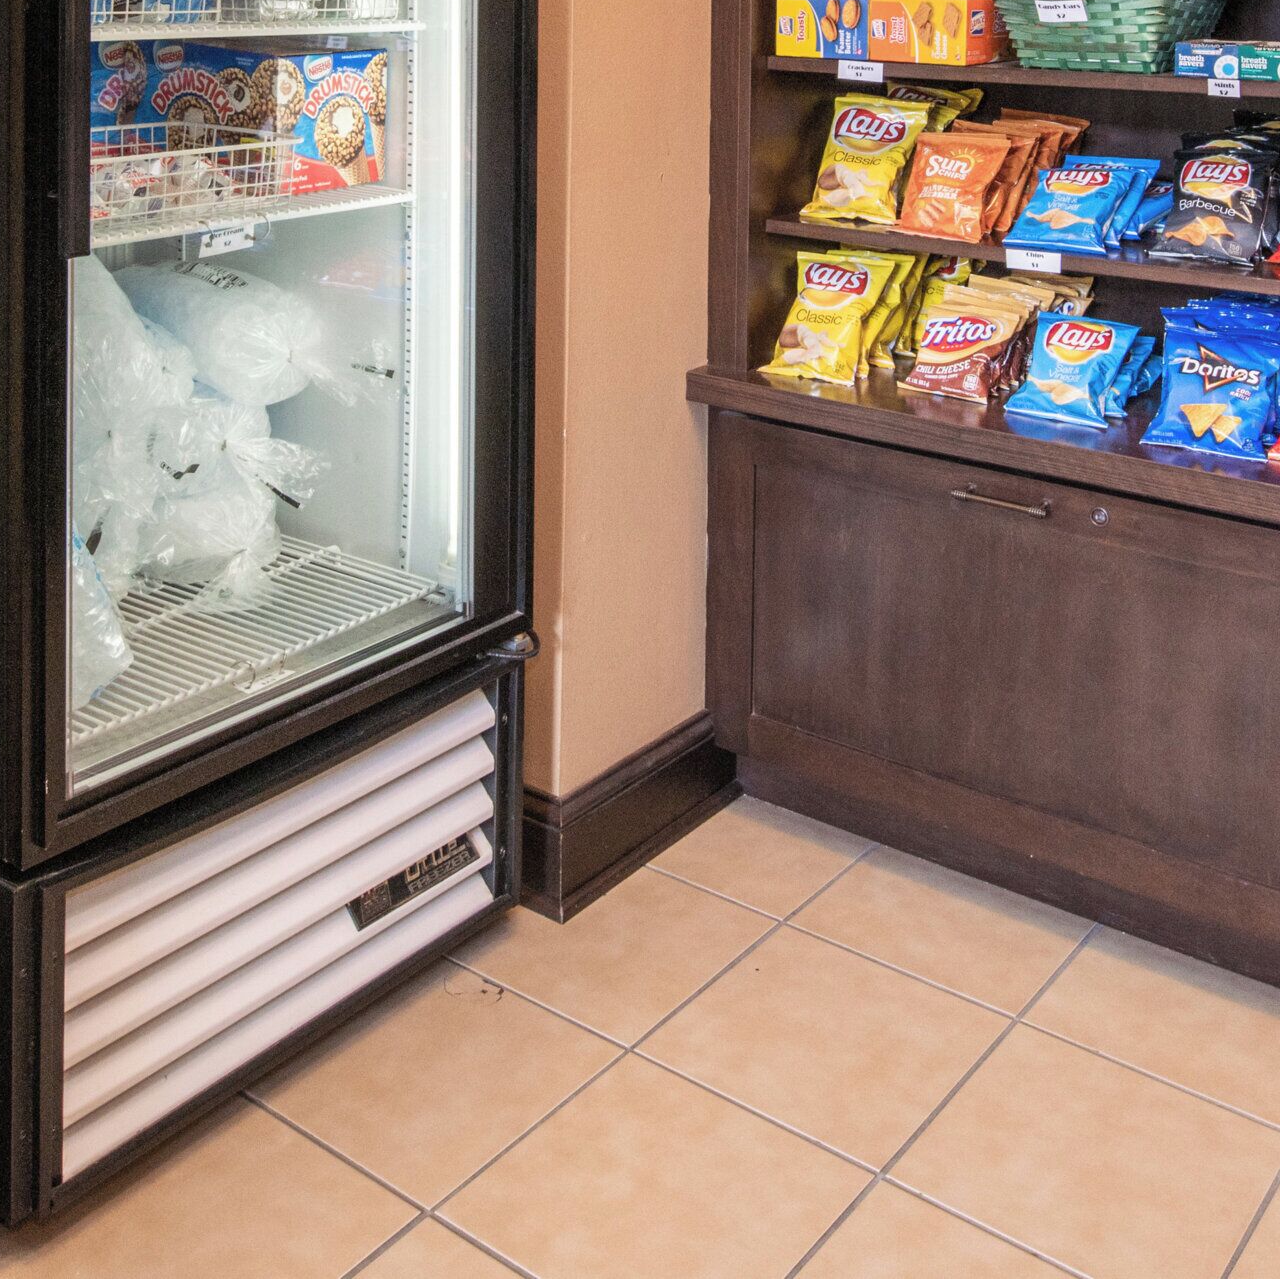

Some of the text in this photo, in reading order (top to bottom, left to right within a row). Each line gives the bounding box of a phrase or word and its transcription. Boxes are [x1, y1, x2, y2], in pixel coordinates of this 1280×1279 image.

[1038, 4, 1061, 13] Candy
[796, 10, 807, 42] Toasty
[837, 29, 845, 54] Peanut
[844, 31, 852, 54] Butter
[1178, 53, 1204, 62] breath
[1240, 56, 1268, 64] breath
[150, 68, 235, 125] DRUMSTICK
[303, 73, 375, 119] DRUMSTICK
[835, 108, 906, 144] Lay's
[833, 150, 883, 166] Classic
[925, 154, 971, 177] Sun
[937, 168, 968, 181] CHIPS
[1184, 161, 1250, 185] Lay's
[1047, 201, 1082, 211] Vinegar
[1178, 198, 1237, 218] Barbecue
[1026, 252, 1045, 260] Chips
[795, 306, 843, 326] Classic
[922, 316, 997, 347] Fritos
[1053, 323, 1113, 351] Lay's
[915, 359, 971, 375] CHILI CHEESE
[1048, 370, 1082, 384] Vinegar
[1181, 356, 1261, 385] Doritos
[409, 851, 471, 893] FREEZER
